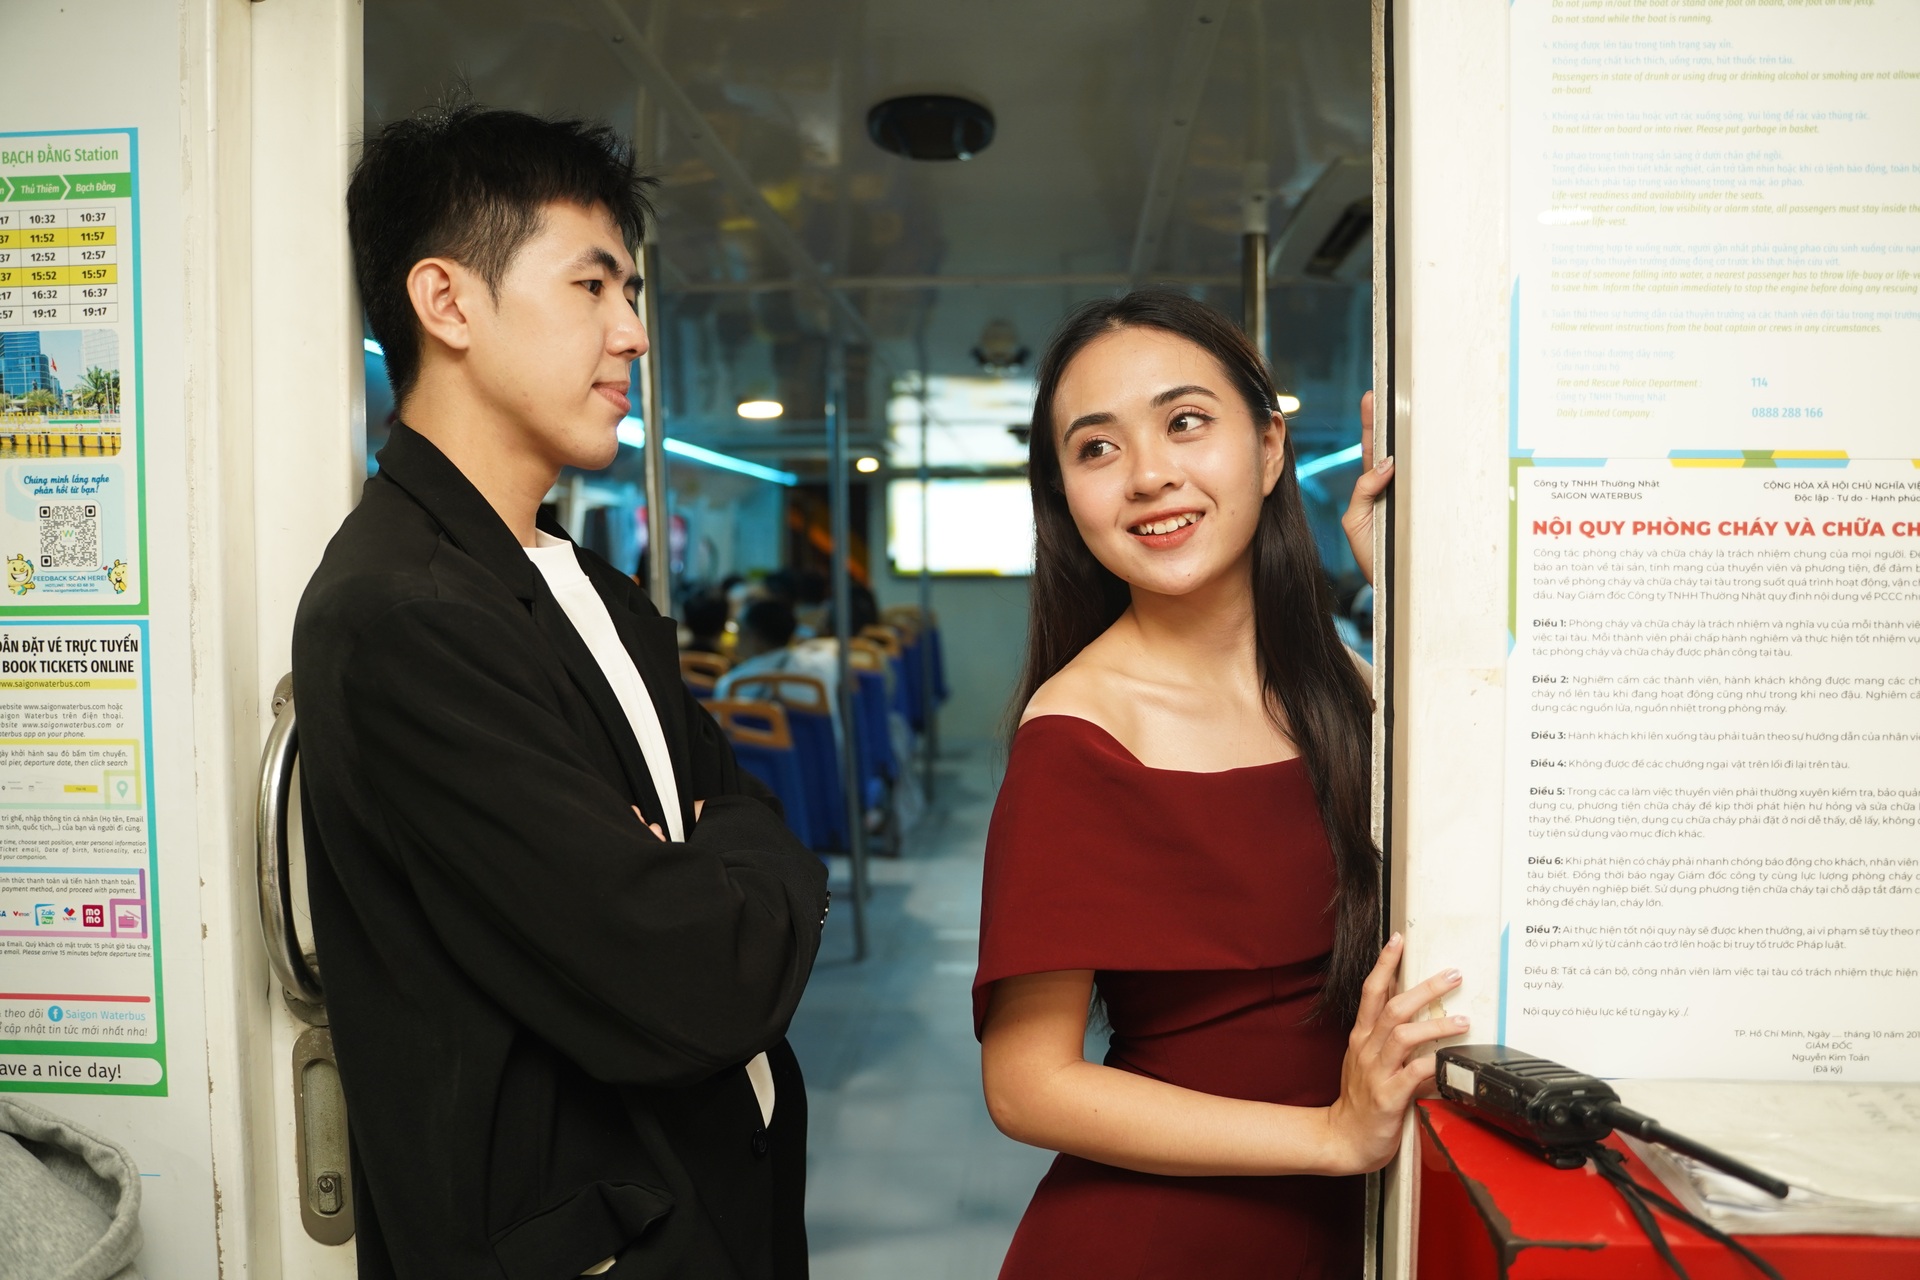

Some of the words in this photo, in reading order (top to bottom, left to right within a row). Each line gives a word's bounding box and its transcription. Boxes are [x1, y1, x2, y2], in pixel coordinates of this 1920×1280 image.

[1552, 125, 1563, 134] Do
[1566, 125, 1579, 134] not
[1582, 124, 1601, 134] litter
[1604, 126, 1614, 134] on
[1618, 124, 1641, 134] board
[1644, 126, 1652, 134] or
[1655, 124, 1671, 134] into
[1697, 124, 1723, 134] Please
[1725, 125, 1739, 135] put
[1742, 124, 1776, 136] garbage
[1779, 124, 1786, 134] in
[1789, 124, 1819, 134] basket.
[2, 151, 34, 168] BẠCH
[38, 144, 71, 163] ĐẰNG
[75, 146, 119, 162] Station
[21, 184, 35, 194] Thủ
[37, 184, 60, 194] Thiêm
[76, 183, 94, 194] Bạch
[96, 180, 116, 193] Đằng
[29, 214, 56, 224] 10:32
[80, 212, 106, 222] 10:37
[30, 234, 55, 243] 11:52
[80, 232, 105, 241] 11:57
[31, 252, 56, 262] 12:52
[81, 250, 106, 260] 12:57
[32, 271, 56, 281] 15:52
[82, 270, 106, 279] 15:57
[32, 290, 58, 300] 16:32
[82, 288, 108, 298] 16:37
[32, 309, 57, 318] 19:12
[83, 308, 107, 317] 19:17
[1557, 378, 1572, 387] Fire
[1573, 378, 1590, 387] and
[1592, 378, 1620, 387] Rescue
[1622, 378, 1646, 388] Police
[1649, 379, 1698, 389] Department
[1752, 377, 1768, 388] 114
[1580, 408, 1610, 417] Limited
[1612, 408, 1650, 418] Company
[1752, 407, 1779, 418] 0888
[1782, 407, 1801, 418] 288
[1804, 407, 1823, 418] 166
[92, 474, 110, 486] nghe
[1534, 480, 1558, 489] Công
[1561, 481, 1568, 489] ty
[1764, 480, 1791, 490] CỘNG
[1794, 480, 1814, 490] HÒA
[1832, 480, 1849, 490] HỘI
[1852, 480, 1872, 490] CHỦ
[1874, 480, 1905, 490] NGHĨA
[1551, 492, 1588, 500] SAIGON
[1590, 492, 1643, 500] WATERBUS
[1794, 494, 1812, 502] Độc
[1837, 494, 1848, 502] Tự
[1851, 494, 1862, 502] do
[1871, 494, 1896, 503] Hạnh
[1532, 516, 1572, 540] NỘI
[1579, 520, 1626, 538] QUY
[1632, 516, 1711, 536] PHÒNG
[1718, 516, 1778, 536] CHÁY
[1784, 516, 1816, 536] VÀ
[1822, 517, 1886, 537] CHỮA
[1892, 521, 1920, 537] CH
[1560, 620, 1567, 628] 1:
[0, 634, 19, 652] ẪN
[22, 636, 45, 656] ĐẶT
[48, 636, 62, 652] VÉ
[65, 638, 97, 656] TRỰC
[100, 634, 138, 652] TUYẾN
[2, 660, 38, 673] BOOK
[40, 660, 88, 673] TICKETS
[90, 660, 134, 673] ONLINE
[0, 680, 90, 690] ww.saigonwaterbus.com
[1560, 676, 1569, 684] 2:
[1558, 732, 1566, 740] 3:
[1558, 760, 1566, 768] 4:
[1646, 760, 1663, 768] các
[1556, 788, 1566, 796] 5:
[1554, 857, 1564, 865] 6:
[1552, 926, 1561, 934] 7:
[5, 1009, 26, 1018] theo
[29, 1009, 44, 1018] dõi
[66, 1010, 98, 1021] Saigon
[100, 1011, 146, 1021] Waterbus
[4, 1024, 21, 1034] cập
[24, 1024, 46, 1035] nhật
[48, 1025, 61, 1034] tin
[64, 1025, 78, 1035] tức
[82, 1025, 100, 1036] mới
[102, 1026, 124, 1036] nhất
[127, 1027, 148, 1036] nha!
[1764, 1030, 1778, 1038] Chí
[1781, 1030, 1805, 1038] Minh,
[1808, 1030, 1830, 1039] Ngày
[1844, 1030, 1870, 1039] tháng
[1873, 1030, 1882, 1038] 10
[1806, 1042, 1830, 1050] GIÁM
[1832, 1040, 1852, 1050] ĐỐC
[0, 1063, 27, 1077] ave
[32, 1065, 42, 1077] a
[48, 1061, 82, 1078] nice
[88, 1062, 122, 1082] day!
